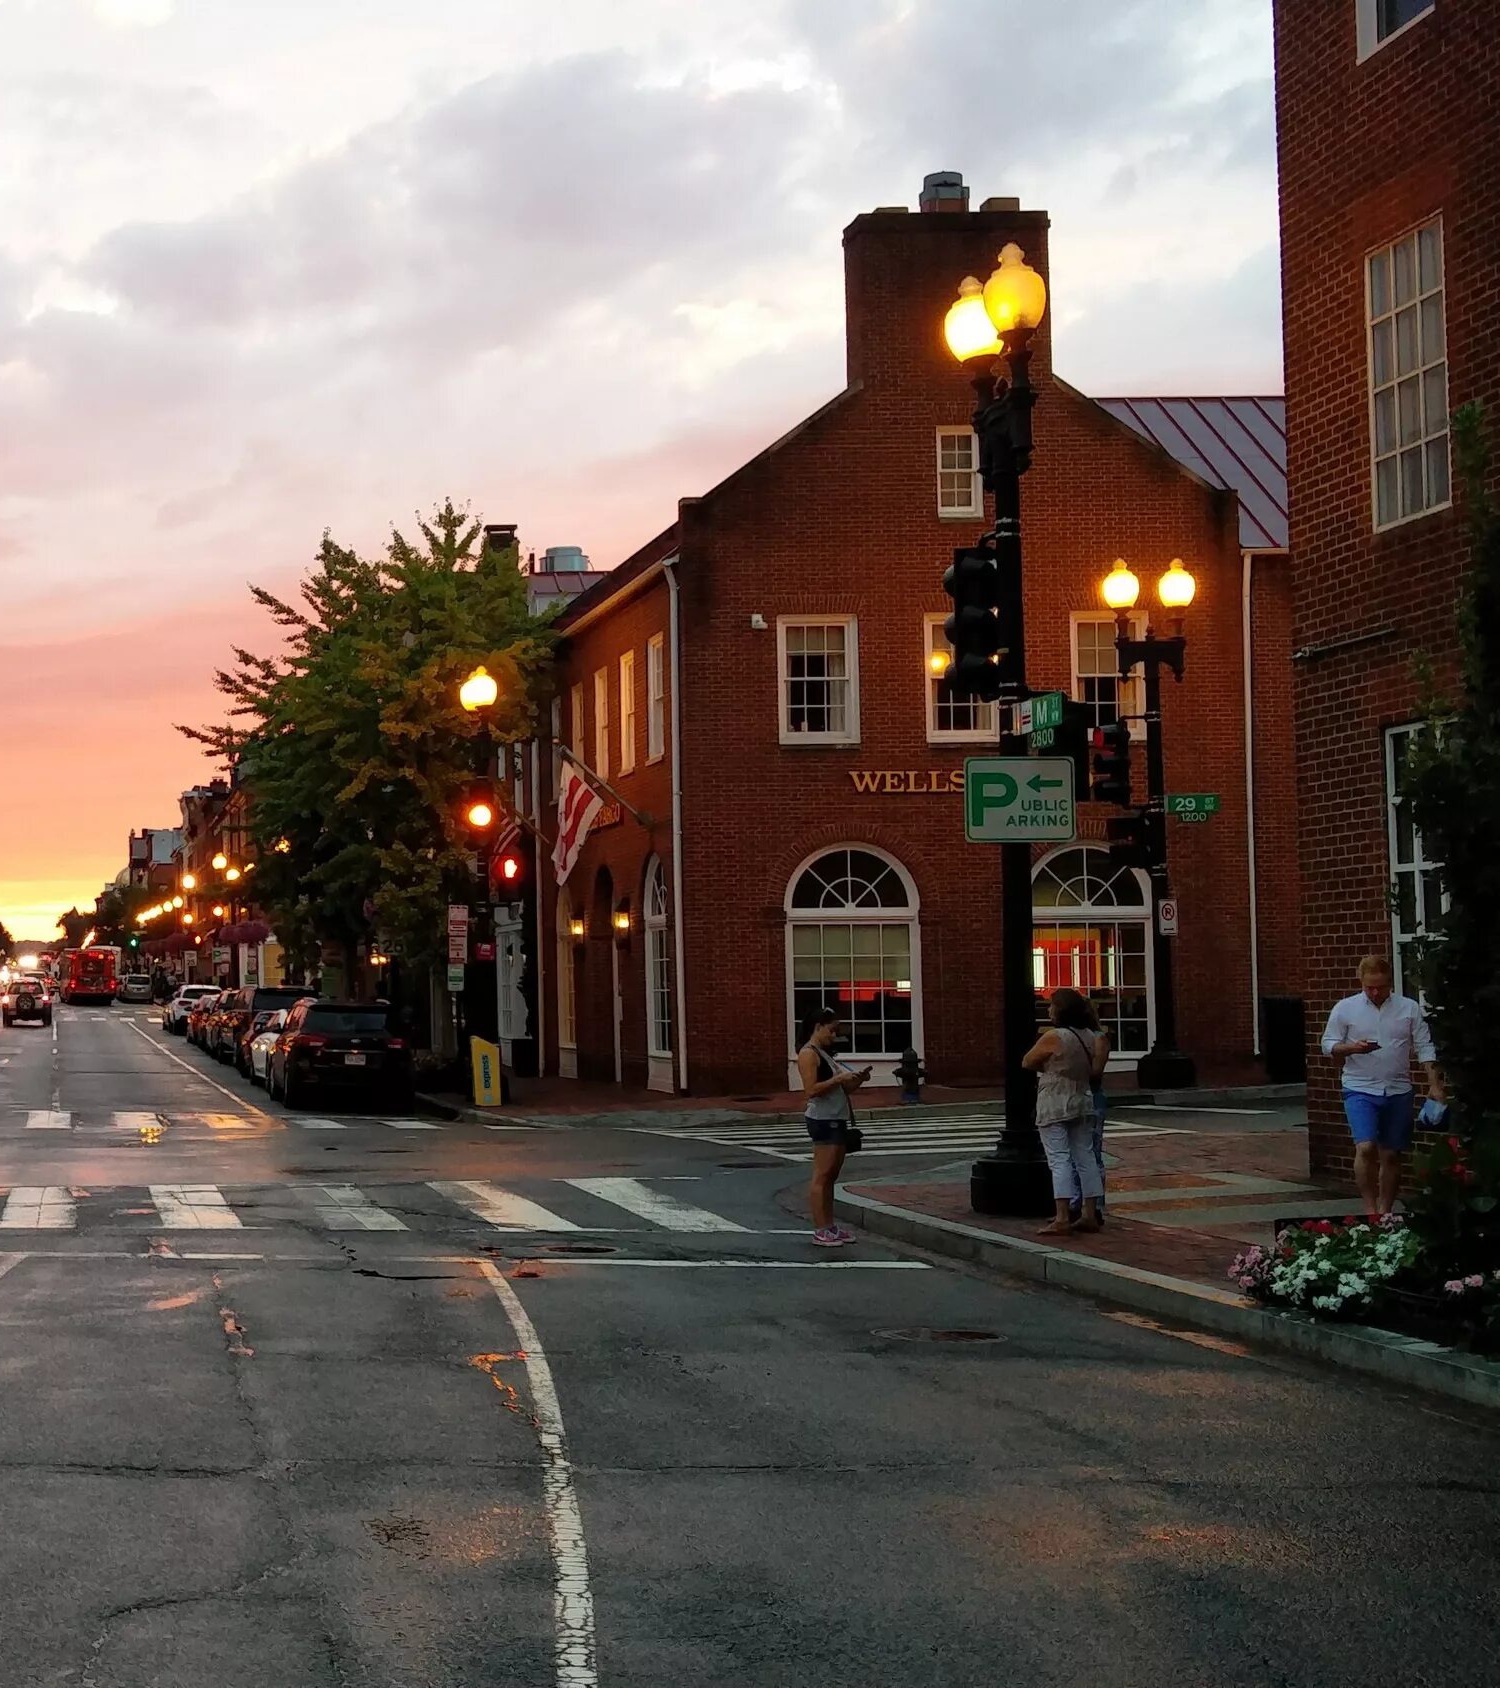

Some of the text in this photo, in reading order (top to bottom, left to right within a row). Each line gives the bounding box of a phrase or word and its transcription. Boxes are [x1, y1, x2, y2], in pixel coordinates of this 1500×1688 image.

[1036, 700, 1047, 726] M
[1030, 728, 1054, 748] 2800
[848, 770, 965, 793] WELLS
[1175, 797, 1196, 811] 29
[1181, 812, 1207, 822] 1200
[482, 1054, 492, 1089] express
